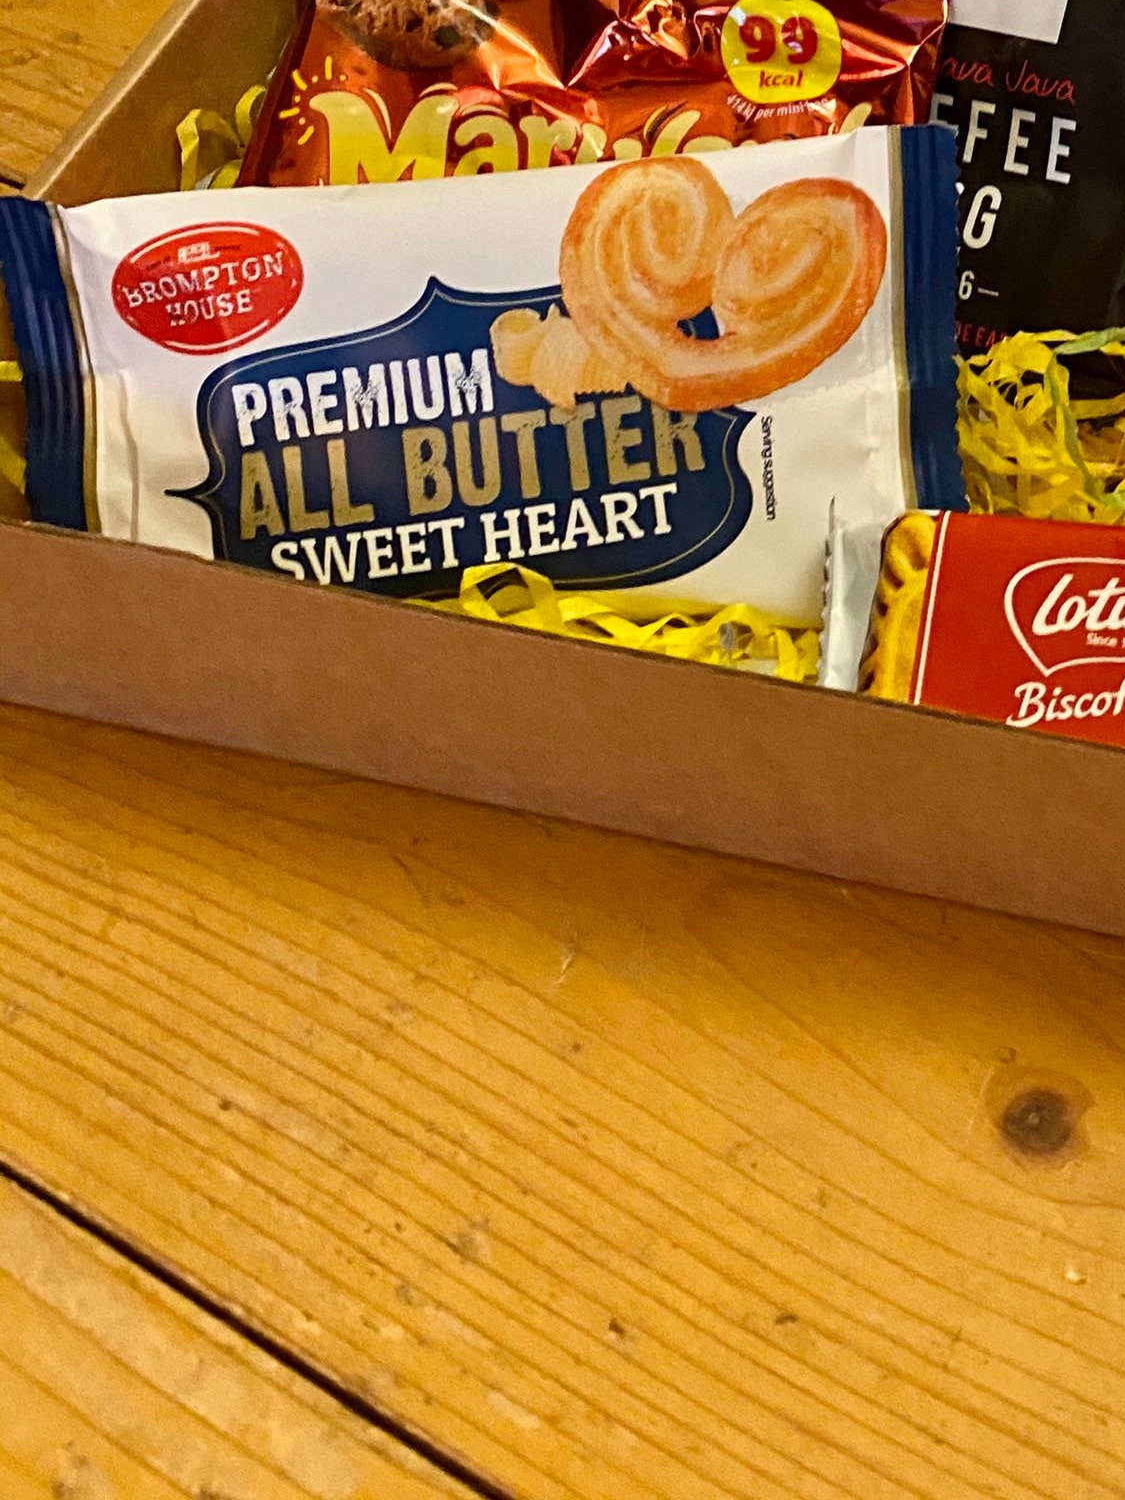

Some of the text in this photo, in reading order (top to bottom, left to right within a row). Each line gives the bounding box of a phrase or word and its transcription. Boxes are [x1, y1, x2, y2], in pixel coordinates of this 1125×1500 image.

[738, 14, 819, 65] 99
[758, 68, 804, 88] kcal
[1005, 59, 1076, 106] Java
[753, 105, 776, 123] per
[930, 92, 1077, 185] FFEE
[122, 251, 284, 308] BROMPTON
[166, 289, 254, 327] HOUSE
[231, 348, 494, 447] PREMIUM
[240, 395, 706, 541] ALL BUTTER
[270, 482, 678, 586] SWEET HEART
[1085, 631, 1118, 649] Since
